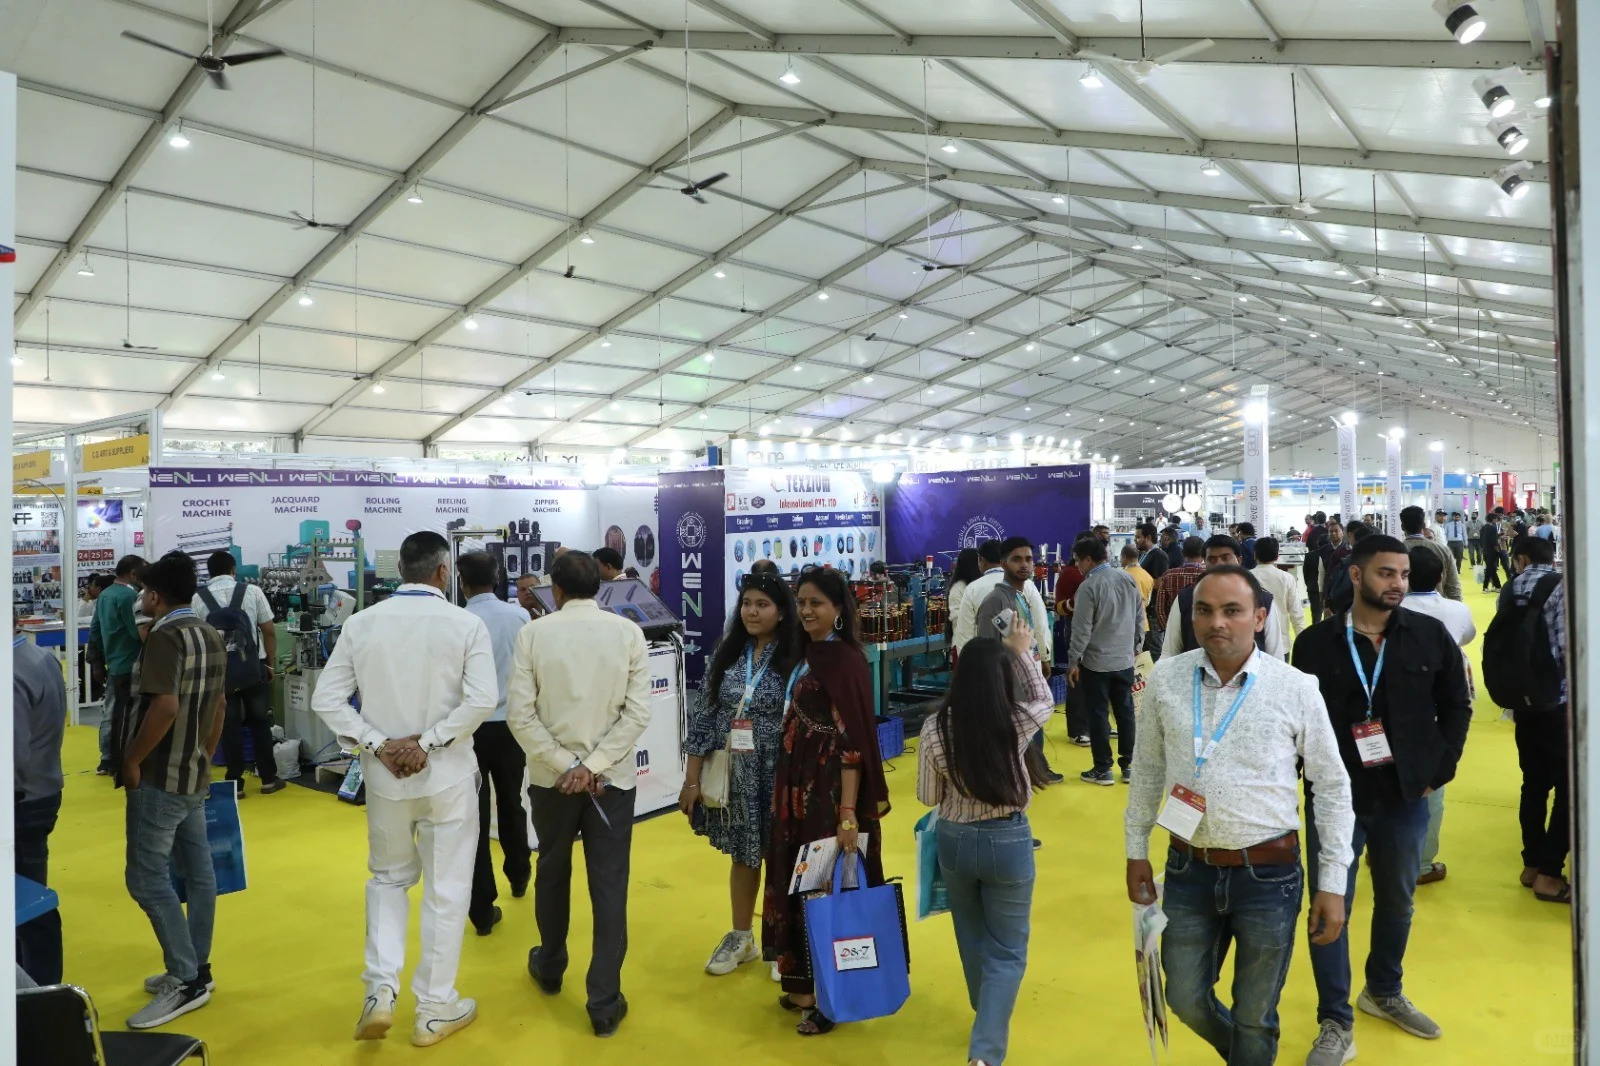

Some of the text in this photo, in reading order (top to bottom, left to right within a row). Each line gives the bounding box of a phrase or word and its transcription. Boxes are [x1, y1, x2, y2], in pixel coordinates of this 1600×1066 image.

[217, 471, 283, 484] WENLI
[289, 471, 350, 484] WENLI
[355, 471, 408, 484] WENLI
[928, 476, 956, 485] WENLI
[967, 474, 997, 484] WENLI
[1006, 472, 1037, 482] WENLI
[1047, 470, 1081, 481] WENLI
[182, 499, 231, 508] CROCHET
[271, 496, 320, 504] JACQUARD
[366, 497, 400, 505] ROLLING
[182, 509, 232, 518] MACHINE
[274, 505, 318, 514] MACHINE
[364, 506, 402, 514] MACHINE
[435, 506, 469, 514] MACHINE
[78, 551, 114, 560] 24 25 26
[97, 560, 115, 568] 2024
